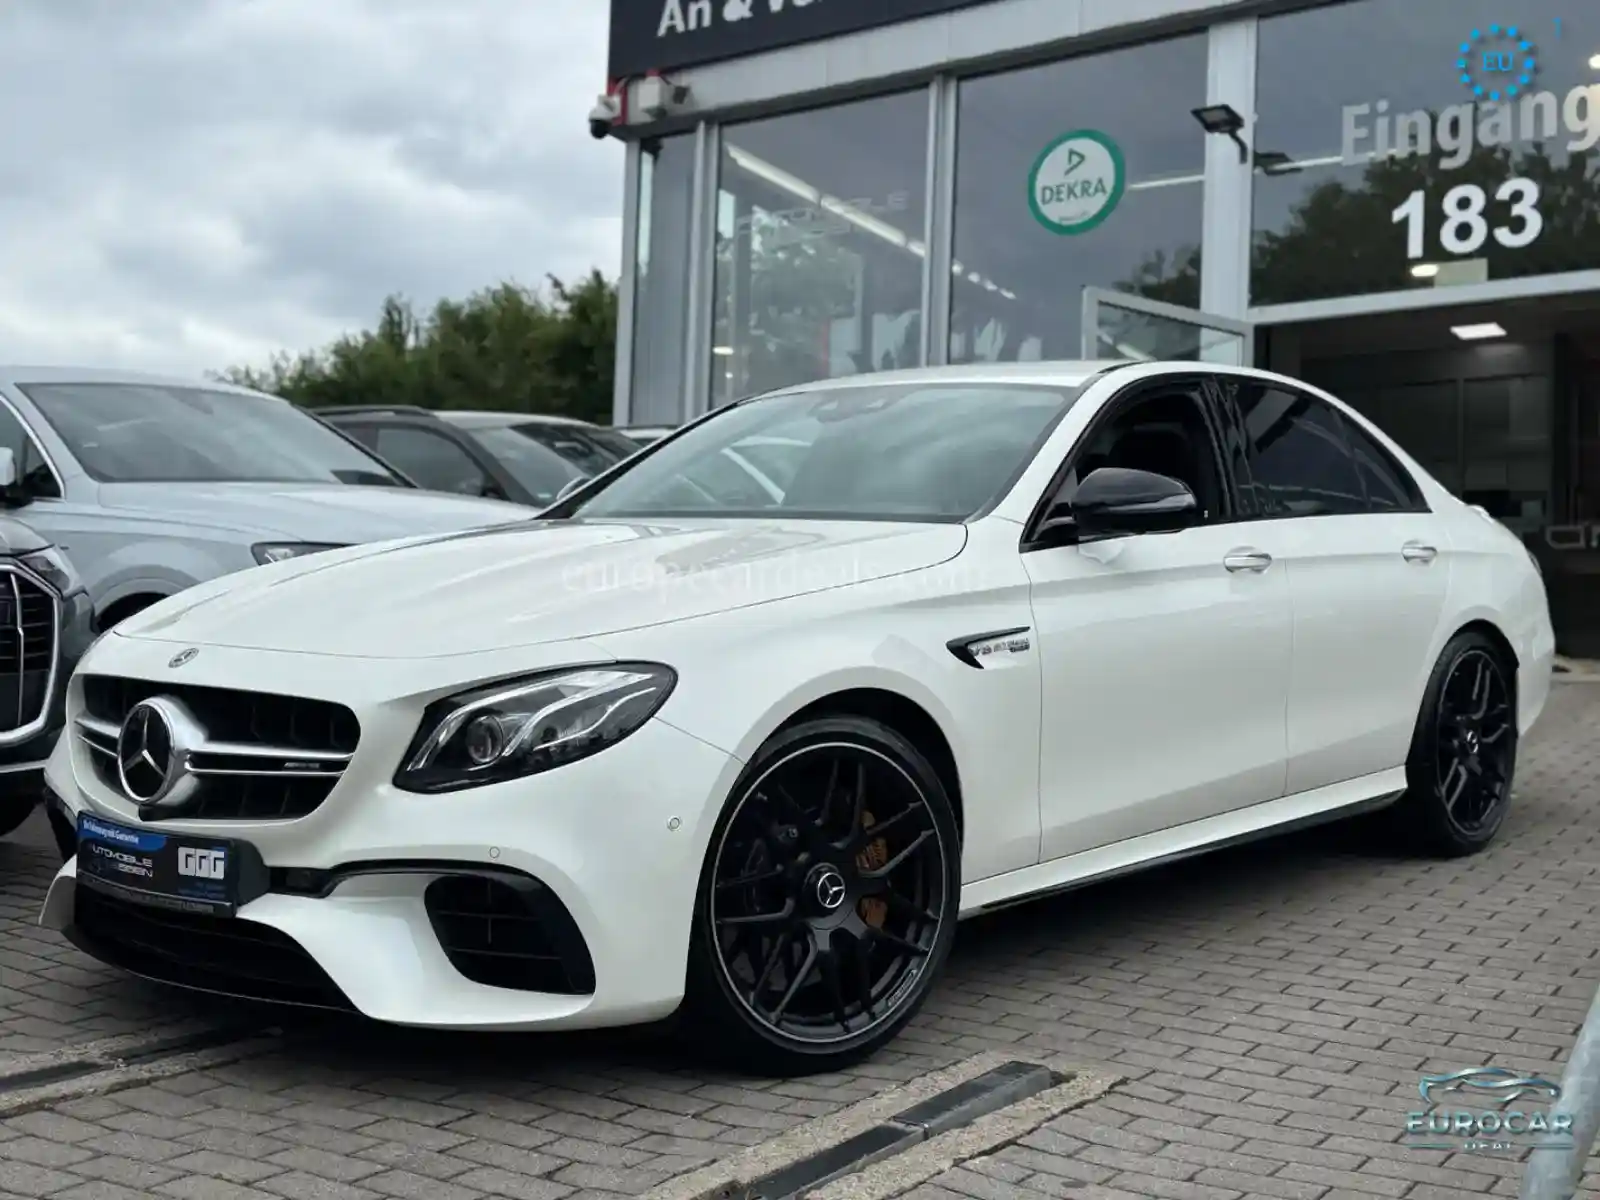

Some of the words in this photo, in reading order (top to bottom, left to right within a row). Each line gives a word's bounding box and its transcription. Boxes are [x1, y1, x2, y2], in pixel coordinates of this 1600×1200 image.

[657, 0, 712, 37] An
[1341, 84, 1600, 169] Eingang
[1041, 177, 1107, 205] DEKRA
[1391, 177, 1543, 259] 183
